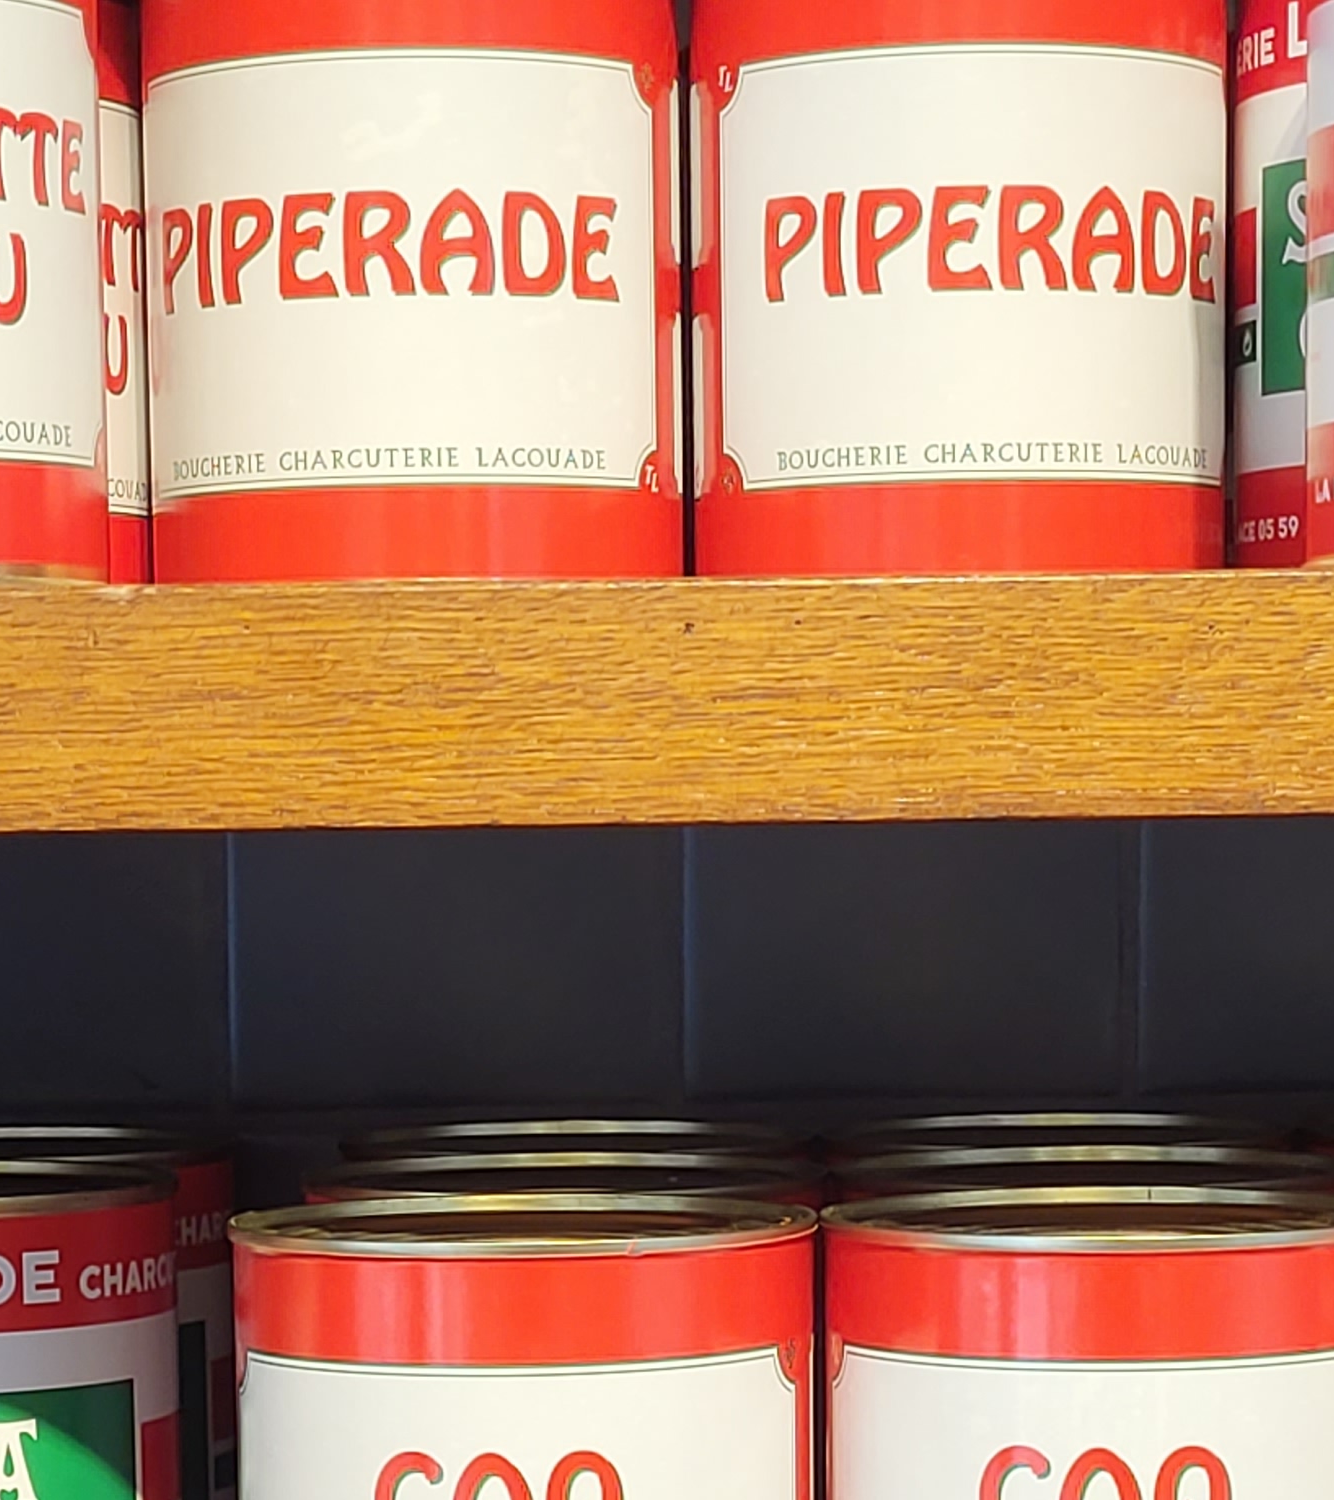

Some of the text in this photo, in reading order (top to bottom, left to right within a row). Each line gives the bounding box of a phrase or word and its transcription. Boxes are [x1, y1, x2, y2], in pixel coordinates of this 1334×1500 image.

[161, 187, 620, 316] PIPERADE
[764, 184, 1216, 305] PIPERADE
[172, 447, 607, 481] BOUCHERIE CHARCUTERIE LACOUADE
[777, 442, 1209, 472] BOUCHERIE CHARCUTERIE LACOUADE
[1257, 518, 1275, 542] 05
